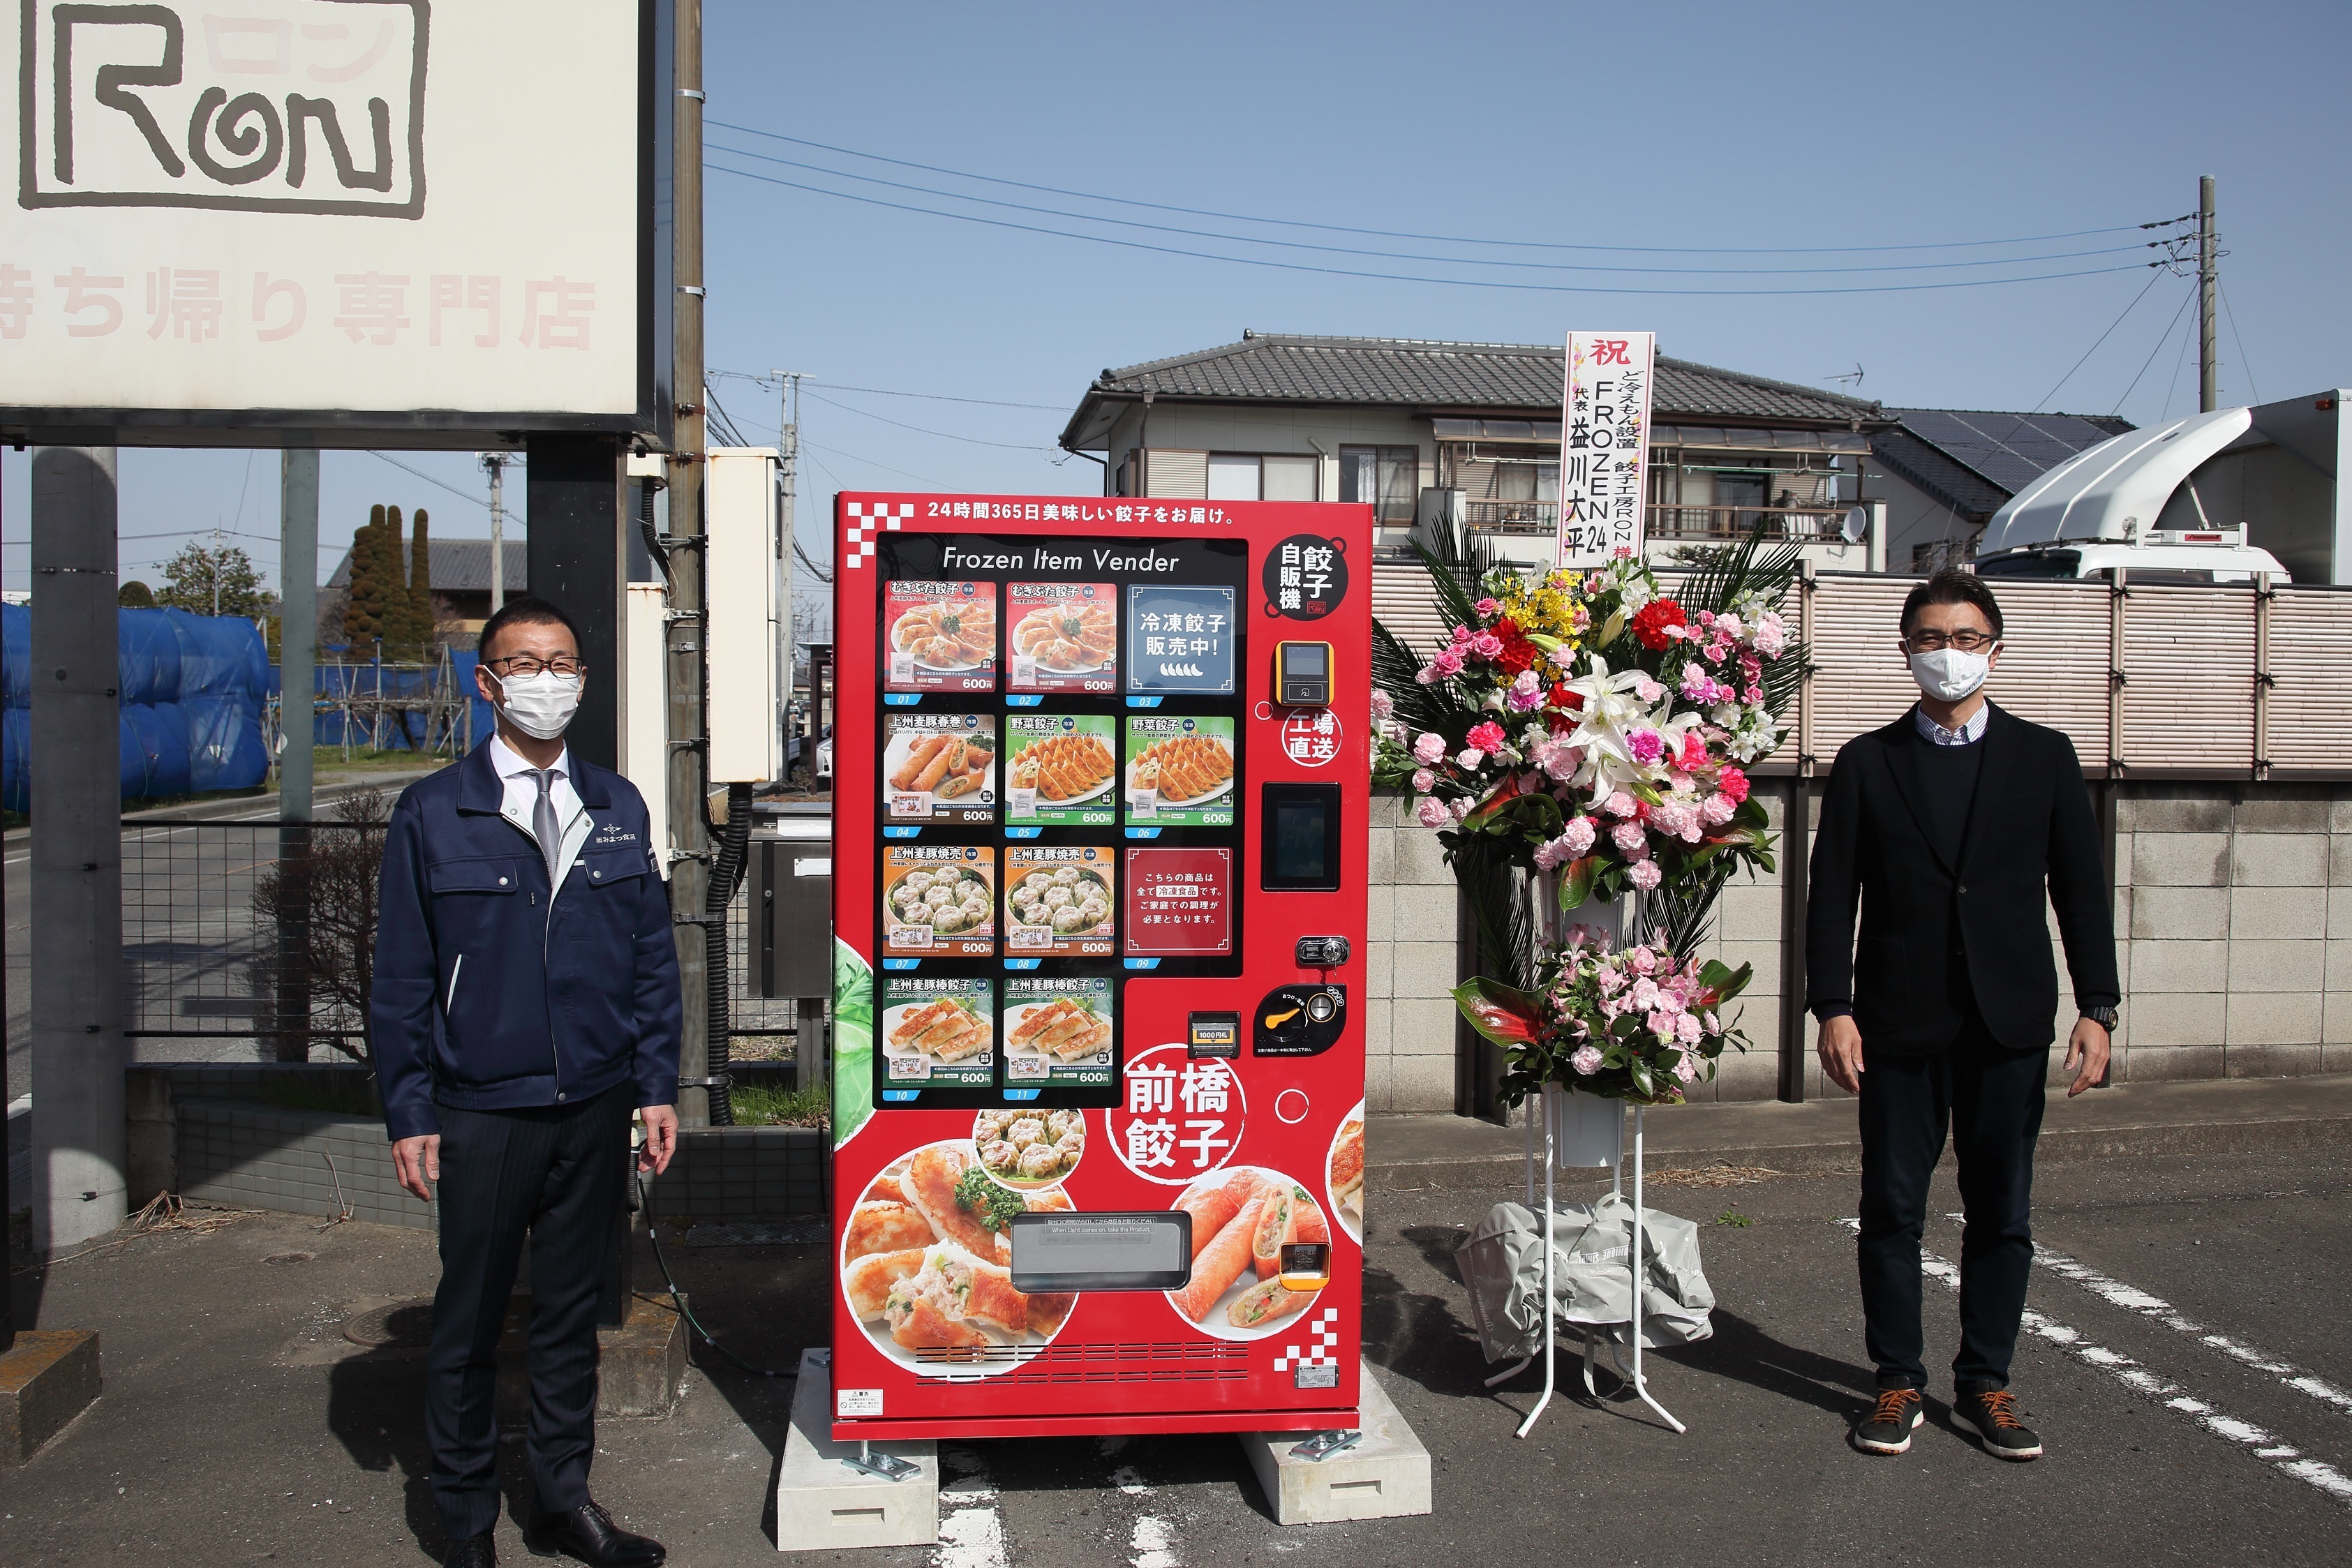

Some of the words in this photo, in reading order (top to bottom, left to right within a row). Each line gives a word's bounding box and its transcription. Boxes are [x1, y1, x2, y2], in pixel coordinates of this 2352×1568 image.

[1589, 338, 1631, 365] 祝
[1573, 388, 1589, 412] 代表
[1615, 371, 1644, 449] ど冷えもん設置
[1565, 415, 1591, 559] 益川大平
[928, 501, 1233, 525] 24時間365日美味しい餃子をお届け。
[943, 546, 1023, 569] Frozen
[1033, 548, 1082, 570] Item
[1092, 548, 1179, 572] Vender
[1279, 542, 1302, 610] 自販機
[1302, 546, 1333, 599] 餃子
[891, 581, 960, 595] むぎぶた餃子
[1012, 585, 1080, 599] むぎぶた餃子
[1140, 612, 1226, 633] 冷凍餃子
[1145, 636, 1217, 657] 販売中!
[962, 679, 992, 689] 600円
[1084, 680, 1114, 691] 600円
[898, 695, 909, 704] 01
[1019, 696, 1031, 705] 02
[1139, 697, 1151, 706] 03
[889, 714, 962, 729] 上州麦豚春巻
[1010, 717, 1059, 731] 野菜餃子
[1131, 718, 1179, 731] 野菜餃子
[1289, 713, 1334, 736] 工場
[1289, 736, 1334, 759] 直送
[963, 811, 992, 821] 600円
[1082, 812, 1112, 823] 600円
[1203, 813, 1232, 823] 600円
[897, 828, 909, 837] 04
[1018, 828, 1029, 837] 05
[1138, 829, 1149, 837] 06
[890, 846, 962, 860] 上州麦豚焼売
[1009, 848, 1080, 861] 上州麦豚焼売
[1145, 873, 1214, 883] こちらの商品は
[1136, 886, 1221, 897] 全て冷凍食品です。
[1140, 900, 1219, 910] ご家庭での調理が
[1142, 914, 1215, 924] 必要となります。
[962, 943, 992, 953] 600円
[1082, 943, 1111, 953] 600円
[895, 960, 908, 969] 07
[1017, 960, 1029, 969] 08
[1137, 959, 1149, 968] 09
[887, 978, 973, 992] 上州麦豚棒餃子
[1006, 978, 1092, 992] 上州麦豚棒餃子
[961, 1073, 990, 1083] 600円
[1080, 1073, 1109, 1082] 600円
[1126, 1063, 1231, 1113] 前橋
[896, 1091, 907, 1100] 10
[1017, 1091, 1027, 1099] 11
[1125, 1118, 1230, 1168] 餃子
